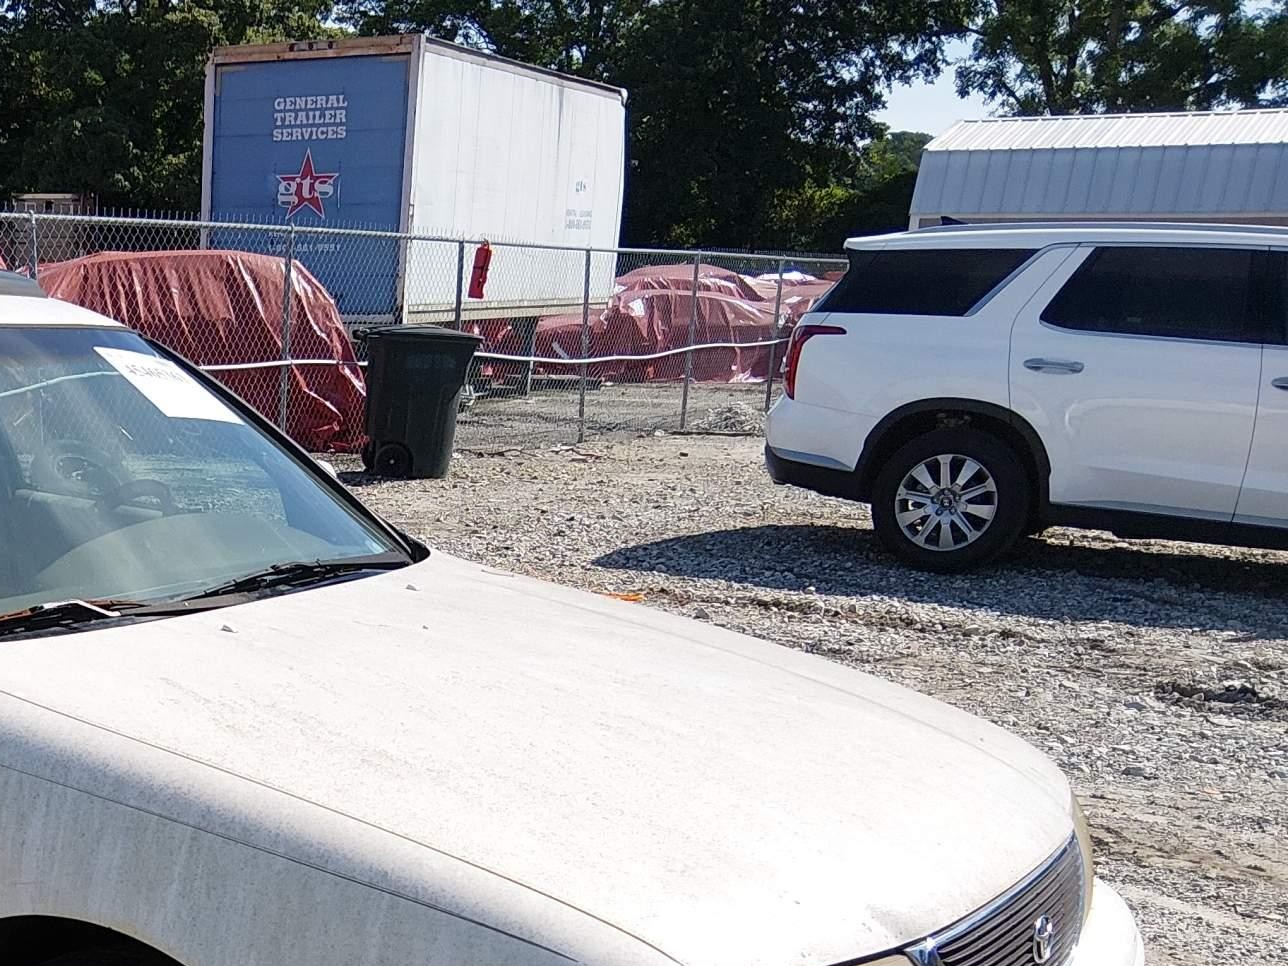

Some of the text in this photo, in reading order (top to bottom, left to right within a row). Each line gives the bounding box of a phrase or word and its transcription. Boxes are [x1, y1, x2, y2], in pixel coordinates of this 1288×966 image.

[274, 94, 348, 110] GENERAL
[274, 109, 347, 126] TRAILER
[272, 126, 347, 142] SERVICES
[277, 174, 334, 208] gts
